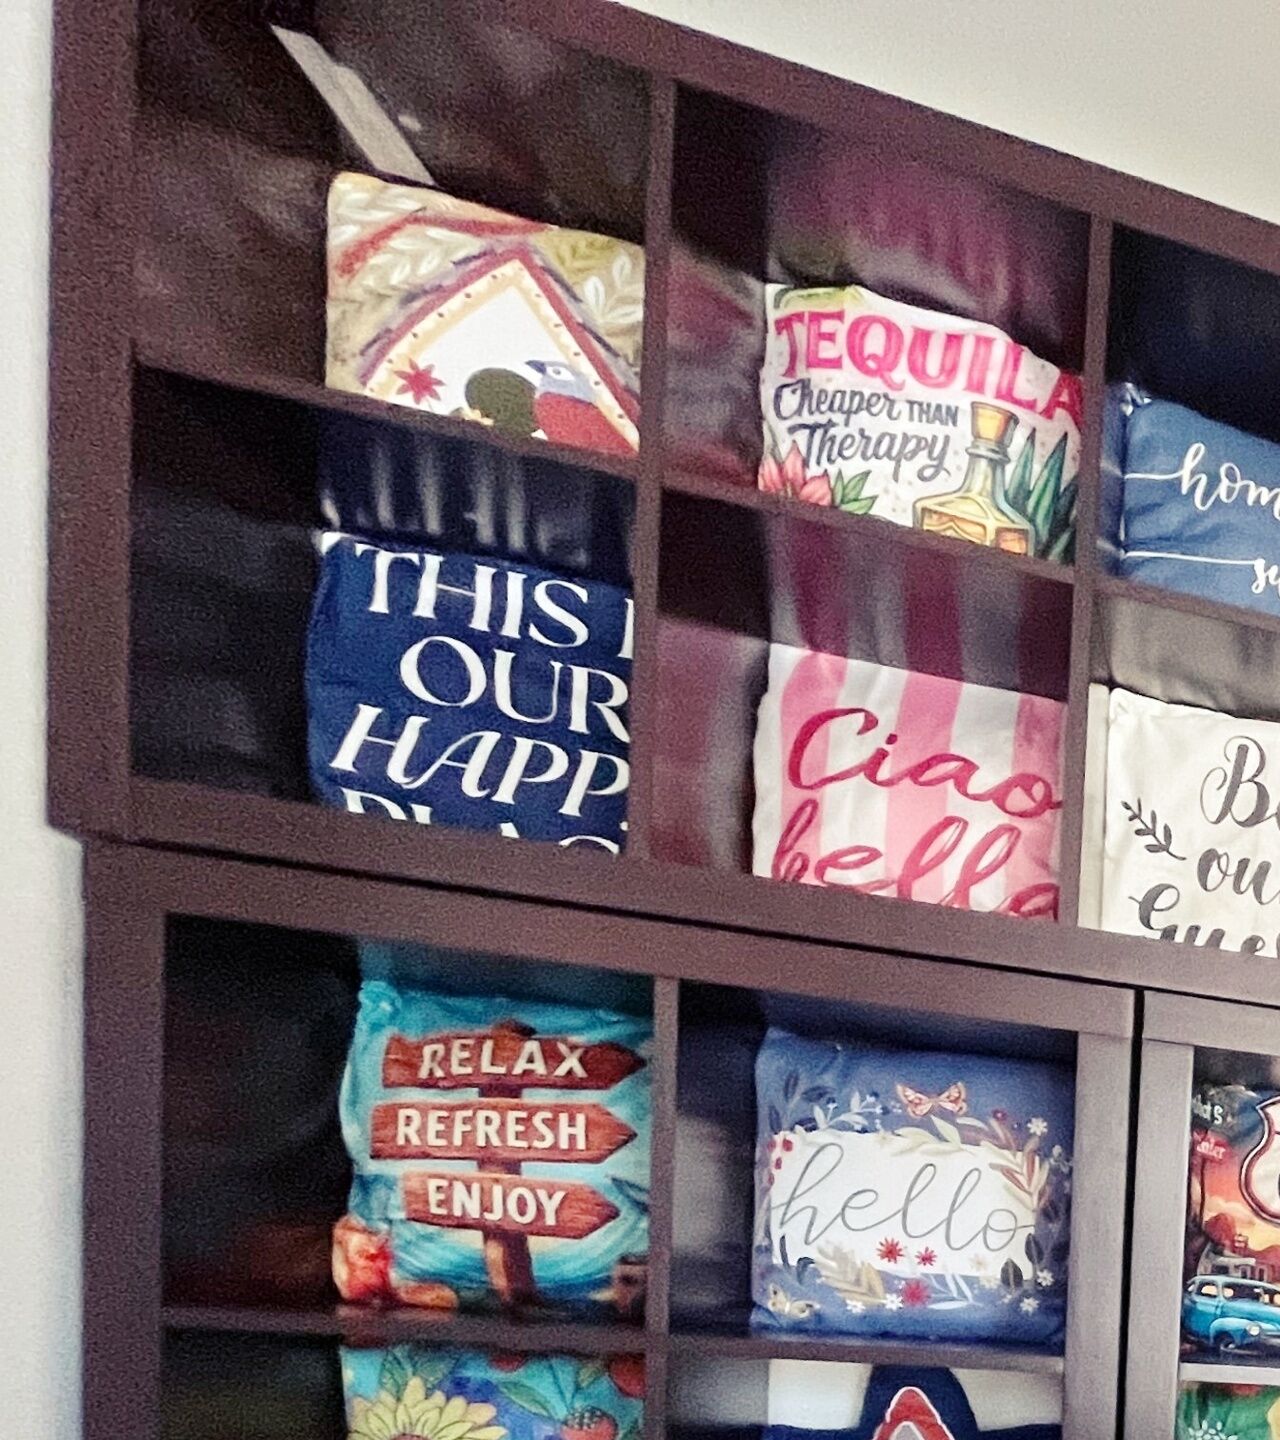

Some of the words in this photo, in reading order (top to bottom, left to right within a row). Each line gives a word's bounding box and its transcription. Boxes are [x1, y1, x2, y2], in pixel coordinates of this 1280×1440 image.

[773, 378, 901, 427] Cheaper
[906, 400, 959, 427] THAN
[775, 310, 1083, 426] TEQUILA
[787, 420, 951, 482] Therapy
[355, 543, 589, 648] THIS
[399, 635, 631, 743] OUR
[788, 707, 1063, 818] Ciao
[418, 1038, 589, 1080] RELAX
[396, 1108, 588, 1151] REFRESH
[426, 1178, 567, 1226] ENJOY
[771, 1142, 1036, 1251] hello
